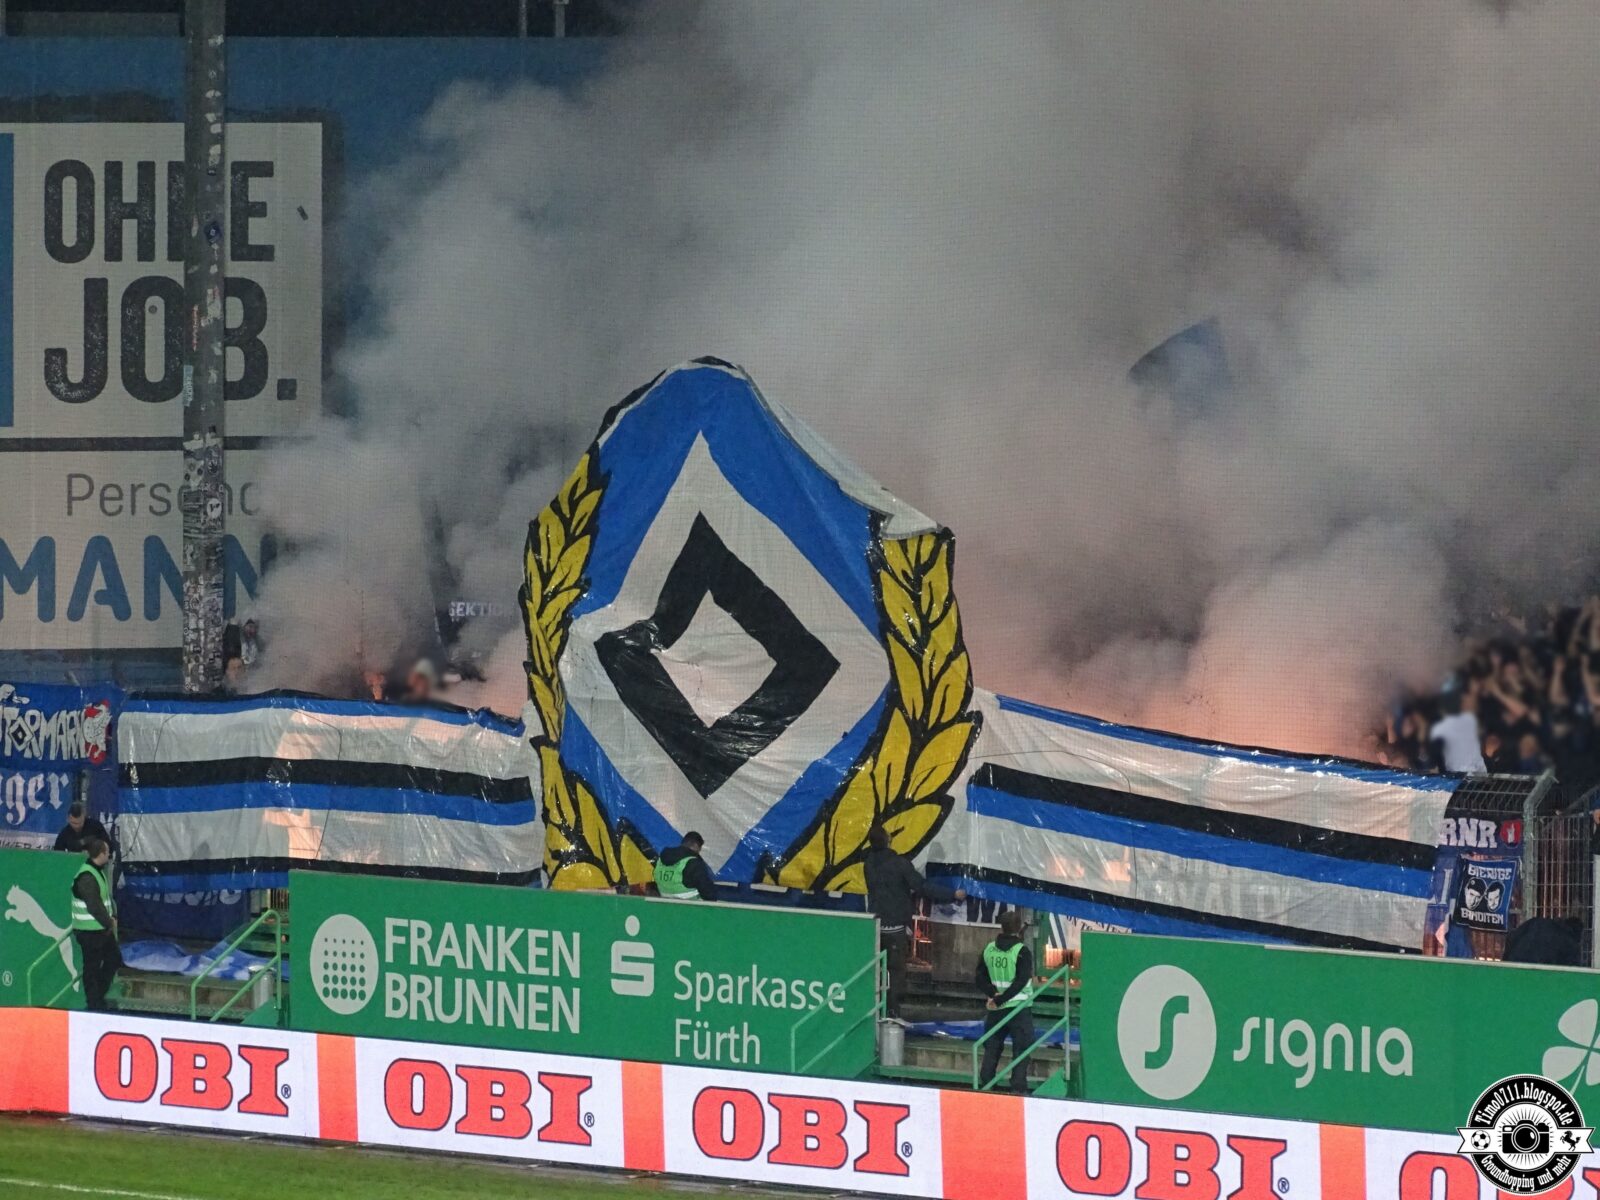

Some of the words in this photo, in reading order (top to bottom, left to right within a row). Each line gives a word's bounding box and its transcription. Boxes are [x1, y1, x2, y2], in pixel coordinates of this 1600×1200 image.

[44, 276, 297, 403] JOB.
[0, 772, 69, 825] ger
[659, 870, 675, 882] 167
[385, 917, 580, 979] FRANKEN
[990, 956, 1008, 969] 180
[385, 972, 580, 1034] BRUNNEN
[674, 960, 847, 1014] Sparkasse
[675, 1018, 761, 1065] Fürth
[1233, 1016, 1413, 1089] signia
[94, 1031, 289, 1117] OBI
[384, 1058, 593, 1146] OBI
[692, 1086, 910, 1177] OBI
[1056, 1119, 1287, 1200] OBI
